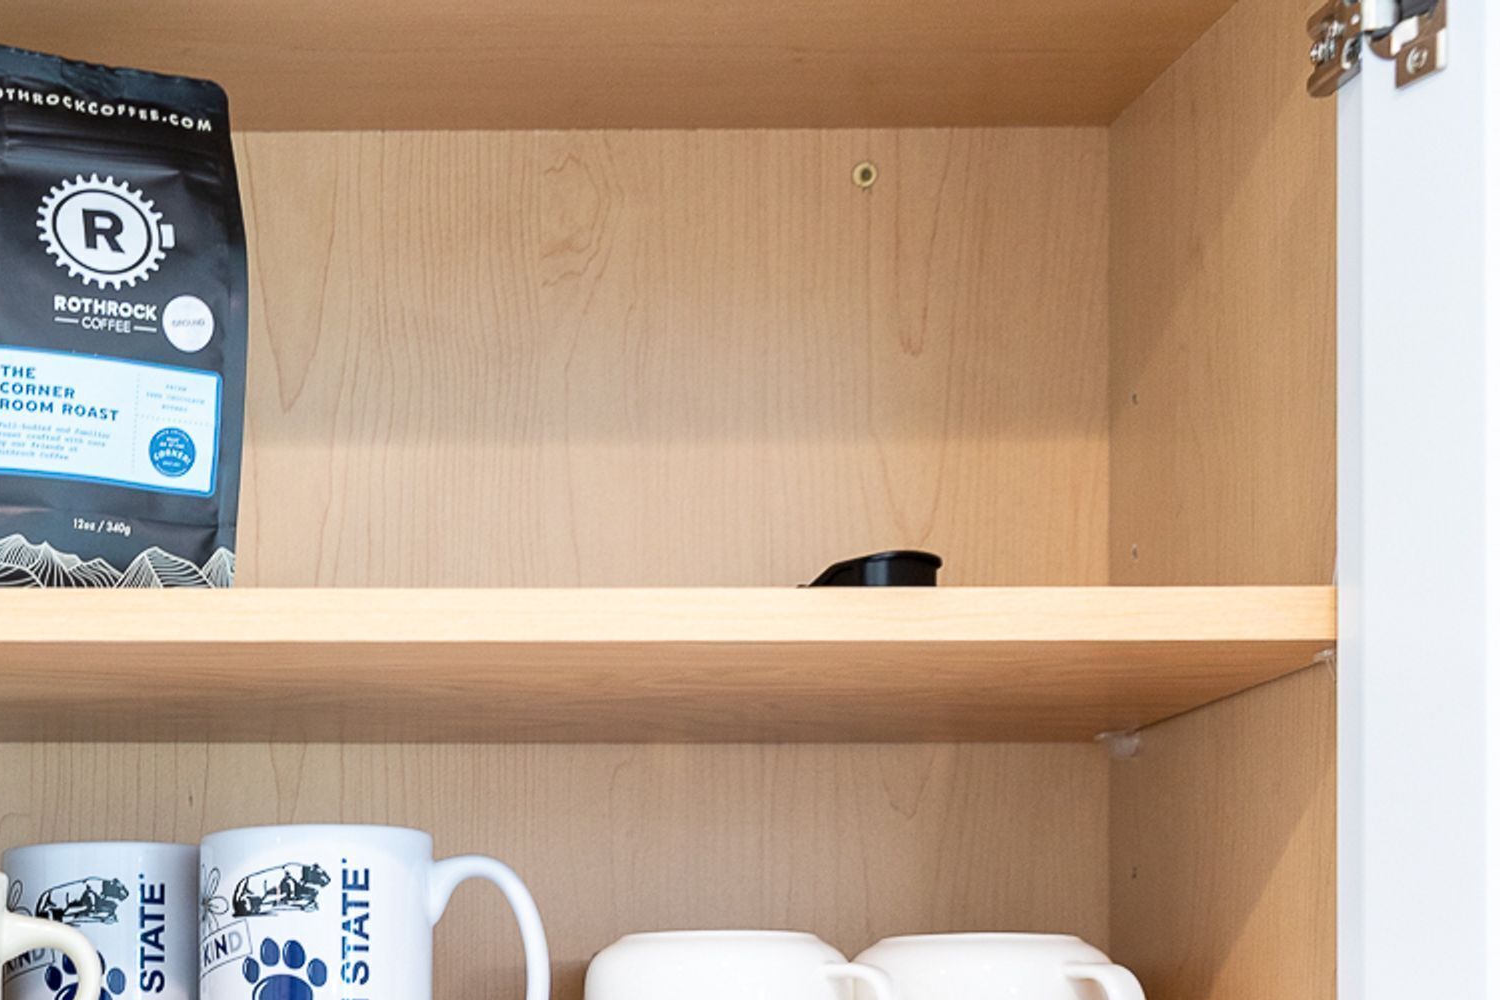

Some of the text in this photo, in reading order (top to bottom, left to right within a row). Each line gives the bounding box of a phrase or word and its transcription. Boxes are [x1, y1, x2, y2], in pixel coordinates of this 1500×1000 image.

[82, 208, 125, 254] R
[53, 294, 157, 321] ROTHROCK
[81, 316, 131, 333] COFFEE
[0, 363, 36, 380] THE
[0, 380, 76, 399] CORNER
[0, 397, 120, 422] ROOM ROAST
[139, 882, 165, 994] STATE
[341, 868, 369, 985] STATE
